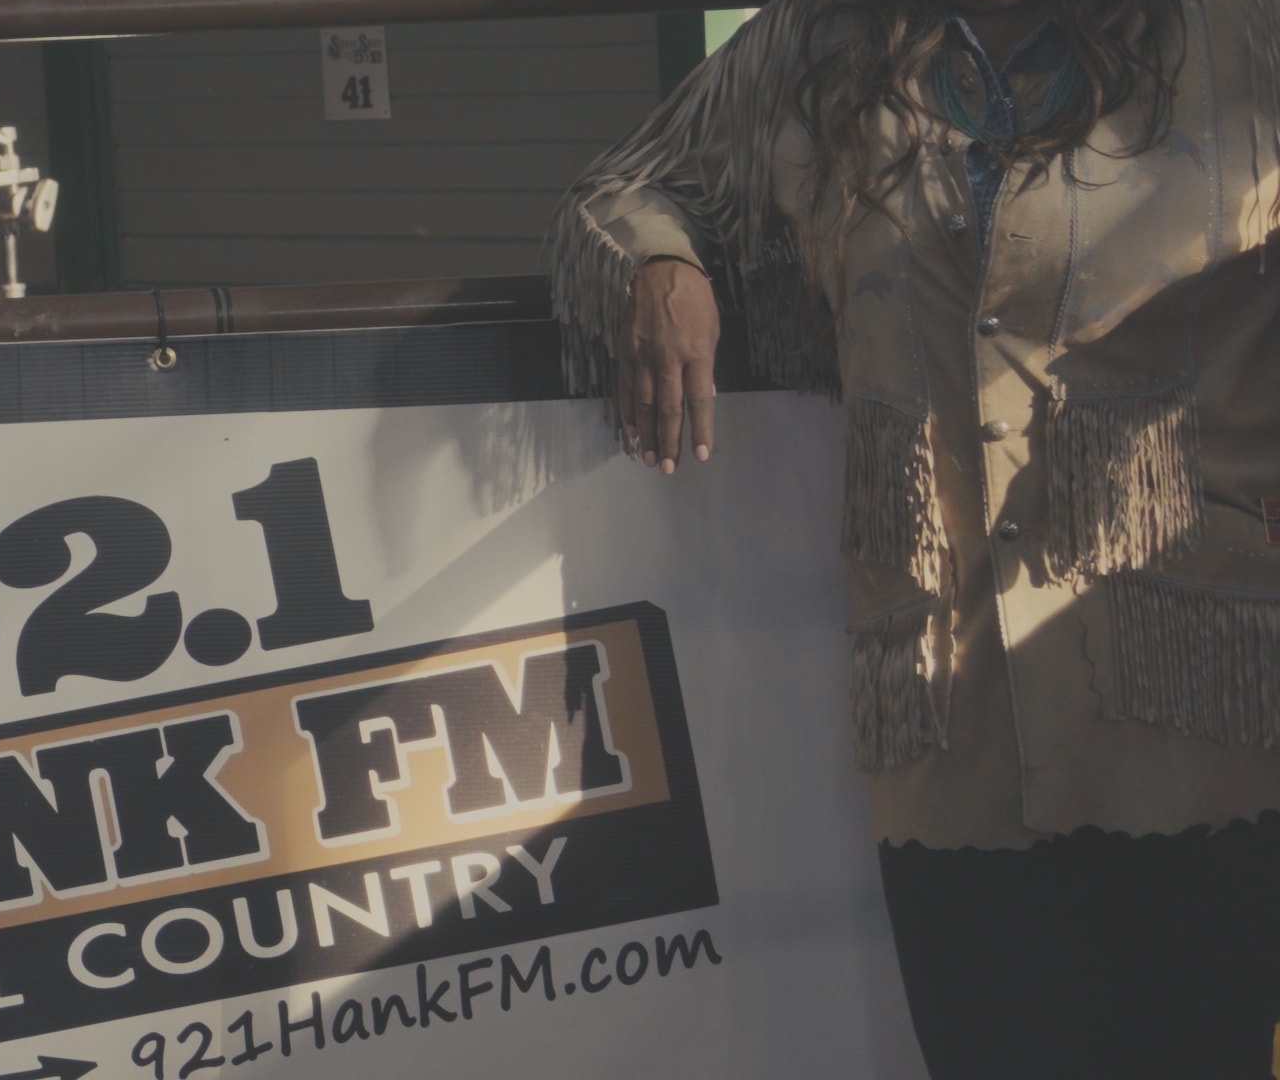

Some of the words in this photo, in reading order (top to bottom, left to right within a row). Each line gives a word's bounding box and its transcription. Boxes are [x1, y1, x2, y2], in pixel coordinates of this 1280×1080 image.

[341, 75, 373, 109] 41
[292, 639, 632, 847] FM
[67, 836, 568, 988] COUNTRY
[131, 929, 723, 1080] 921HankFM.com
